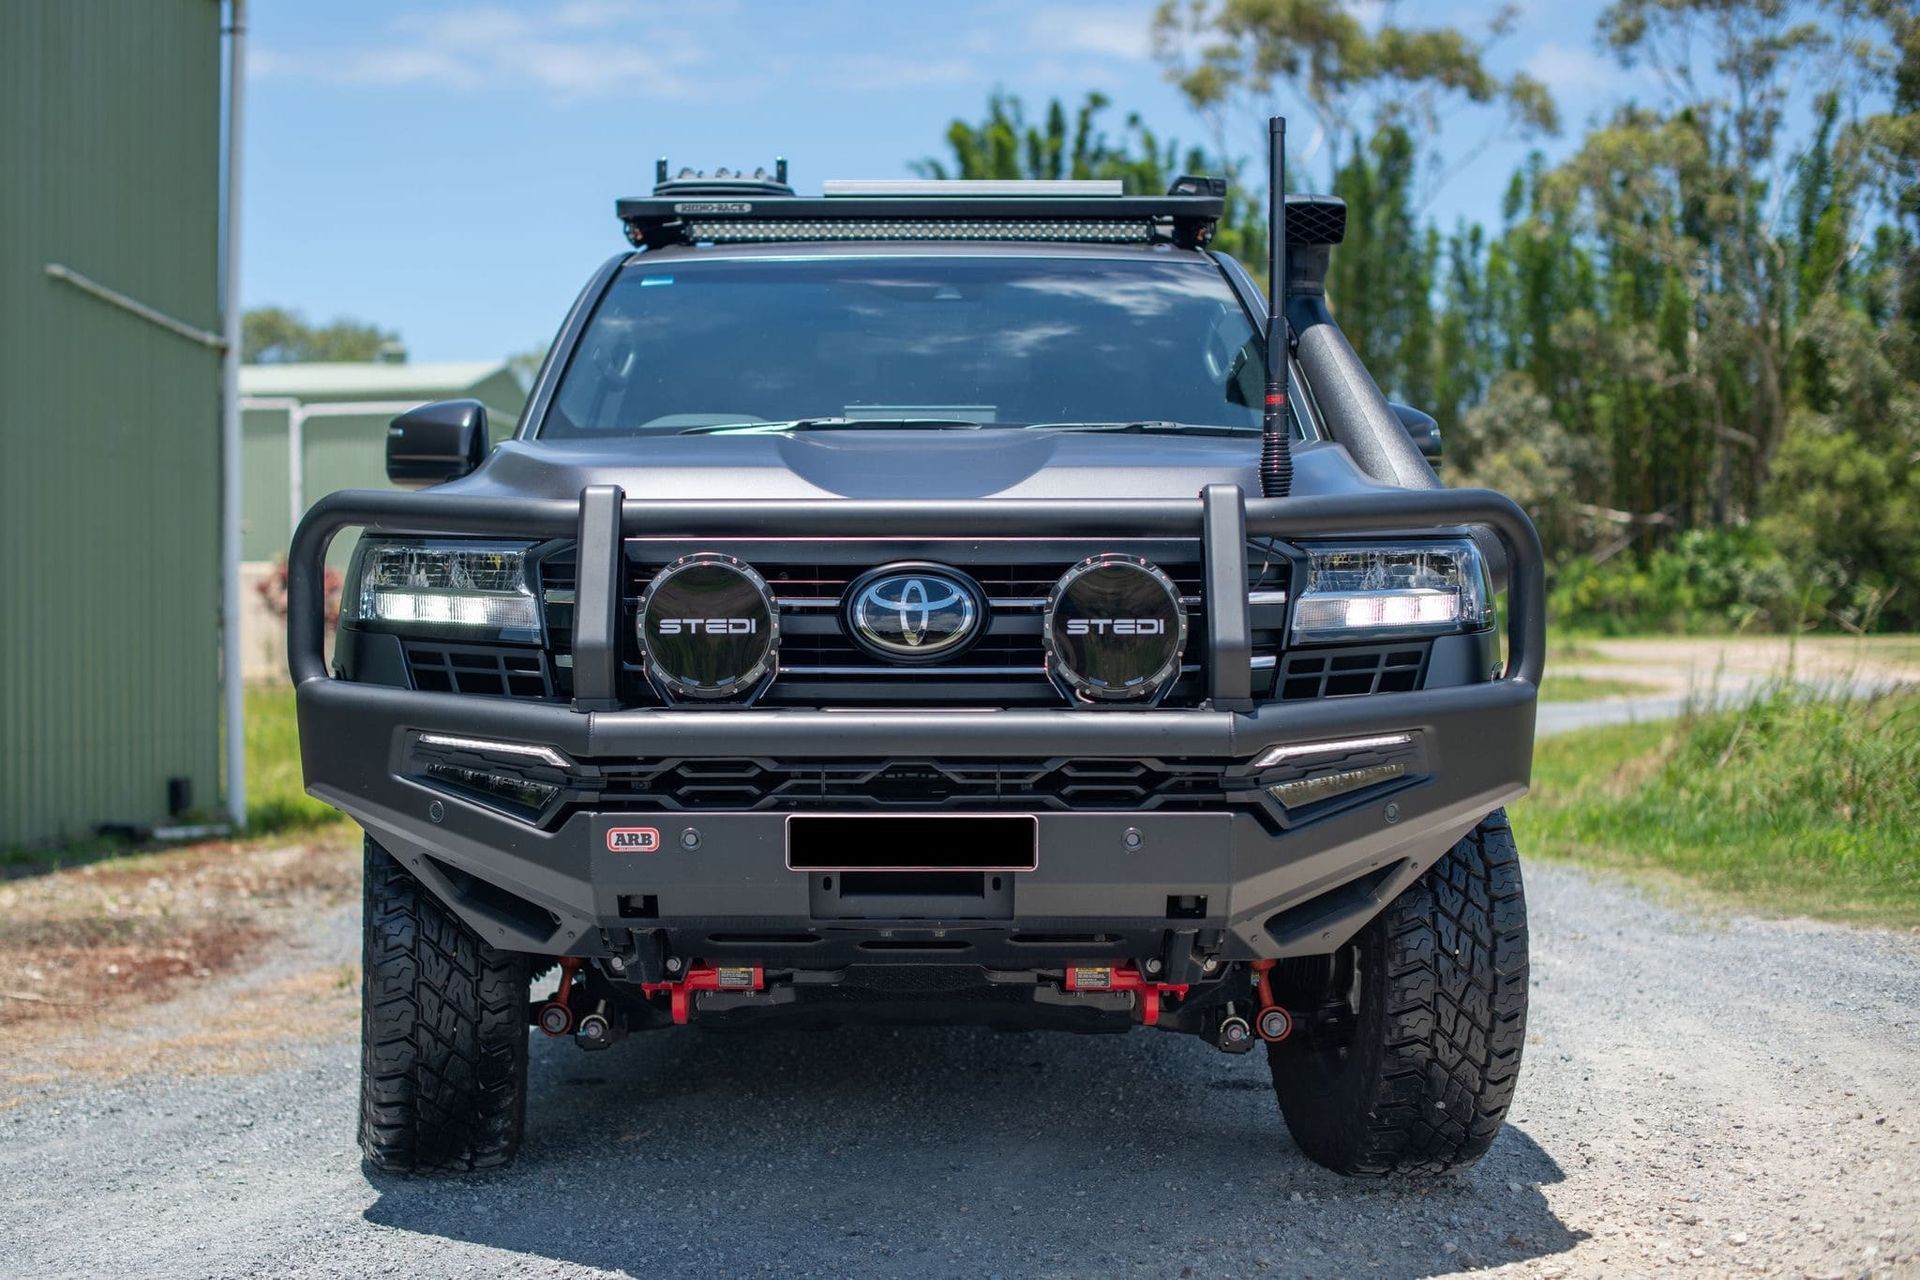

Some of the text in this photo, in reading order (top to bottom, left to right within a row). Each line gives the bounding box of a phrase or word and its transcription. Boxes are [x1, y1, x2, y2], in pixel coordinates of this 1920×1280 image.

[659, 618, 756, 634] STEDI
[1066, 618, 1164, 635] STEDI
[614, 833, 653, 847] ARB
